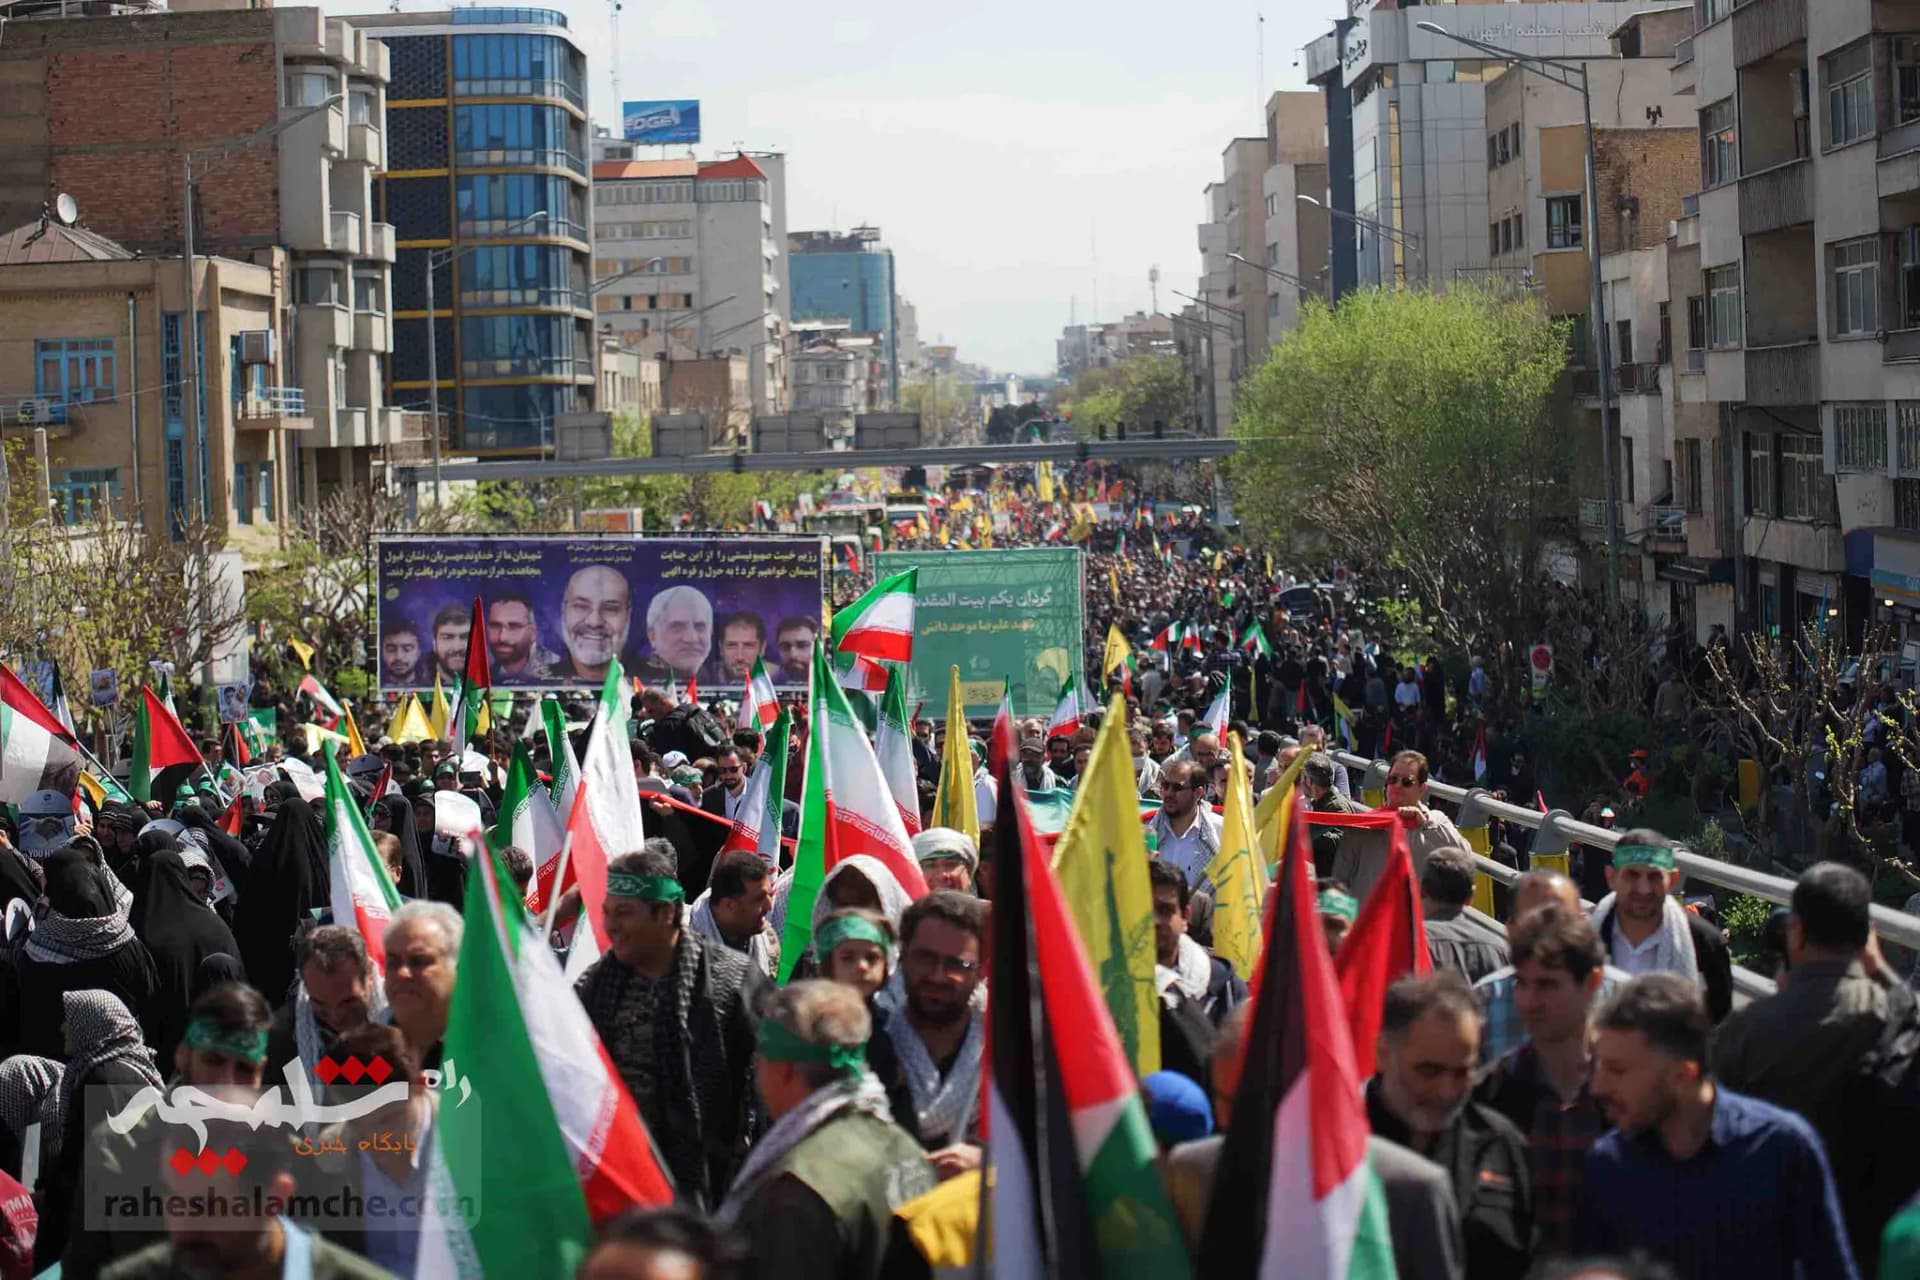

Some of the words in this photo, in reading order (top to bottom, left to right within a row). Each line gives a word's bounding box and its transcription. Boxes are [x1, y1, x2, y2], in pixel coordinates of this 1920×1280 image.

[1515, 23, 1562, 37] منطقه
[384, 550, 404, 563] قبول
[405, 549, 426, 563] نشان
[464, 550, 494, 563] خداوند
[512, 549, 543, 563] شهیدان
[660, 549, 687, 563] جنایت
[688, 549, 704, 563] این
[704, 550, 714, 563] از
[717, 550, 726, 563] را
[727, 550, 772, 563] صهیونیستی
[774, 549, 796, 562] خبیث
[797, 550, 818, 563] رژیم
[506, 565, 542, 577] مجاهدت
[661, 565, 681, 579] الهی
[704, 566, 724, 579] حول
[757, 566, 788, 579] خواهیم
[788, 566, 818, 579] پشیمان
[958, 591, 986, 608] بیت
[988, 588, 1014, 611] یکم
[1015, 586, 1053, 607] گردان
